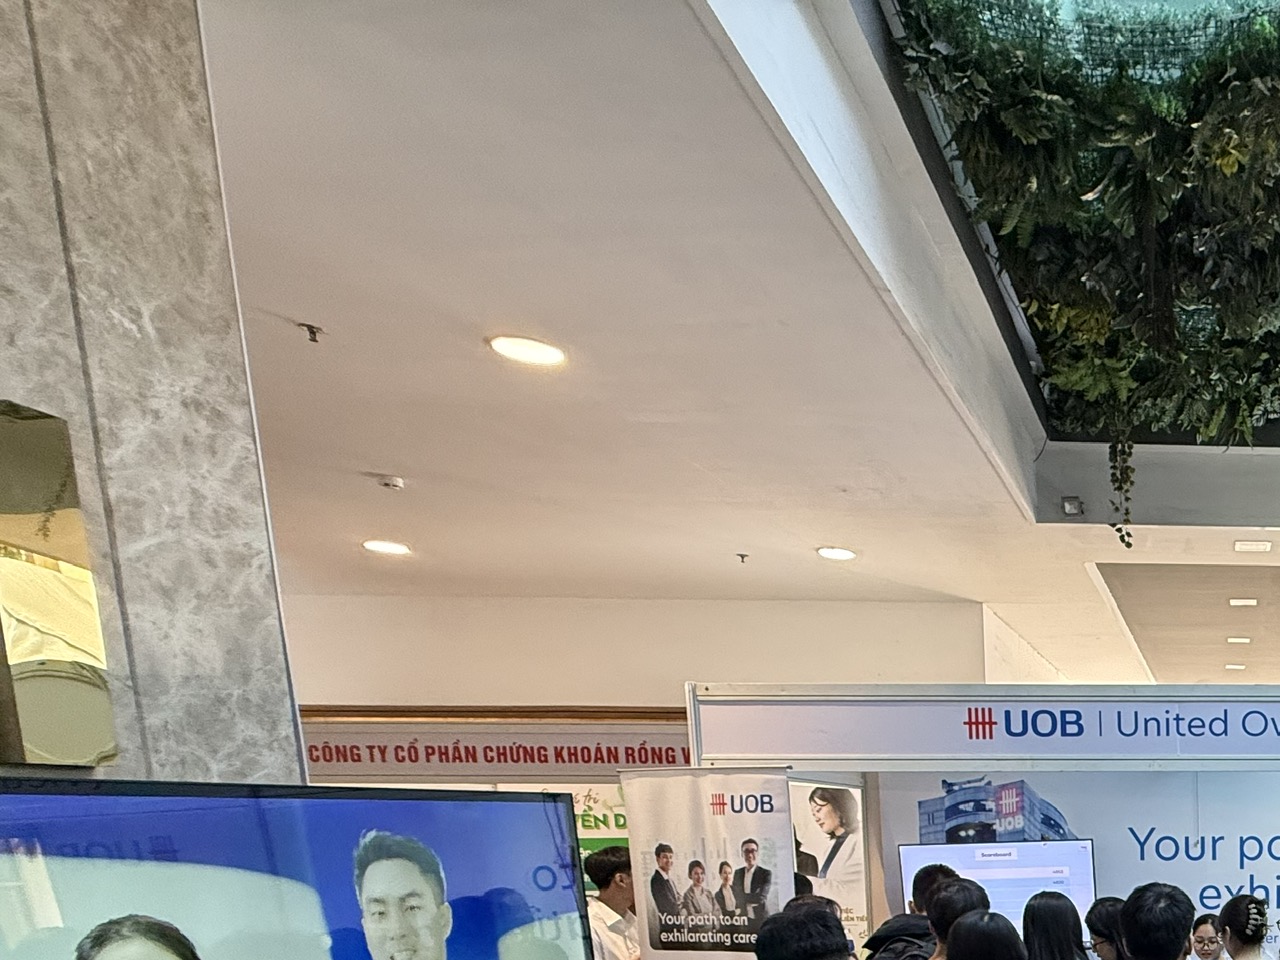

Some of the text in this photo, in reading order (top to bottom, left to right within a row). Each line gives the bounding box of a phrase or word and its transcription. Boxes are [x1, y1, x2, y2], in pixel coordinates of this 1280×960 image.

[1003, 709, 1085, 737] UOB
[1116, 709, 1229, 738] United
[308, 741, 362, 763] CÔNG
[365, 745, 388, 763] TY
[424, 739, 478, 764] PHẦN
[483, 742, 549, 764] CHỨNG
[553, 742, 619, 764] KHOÁN
[624, 740, 677, 765] RỒNG
[730, 794, 774, 813] UOB
[1127, 827, 1225, 862] Your
[658, 912, 748, 928] Your path to an
[660, 931, 758, 946] exhilarating care
